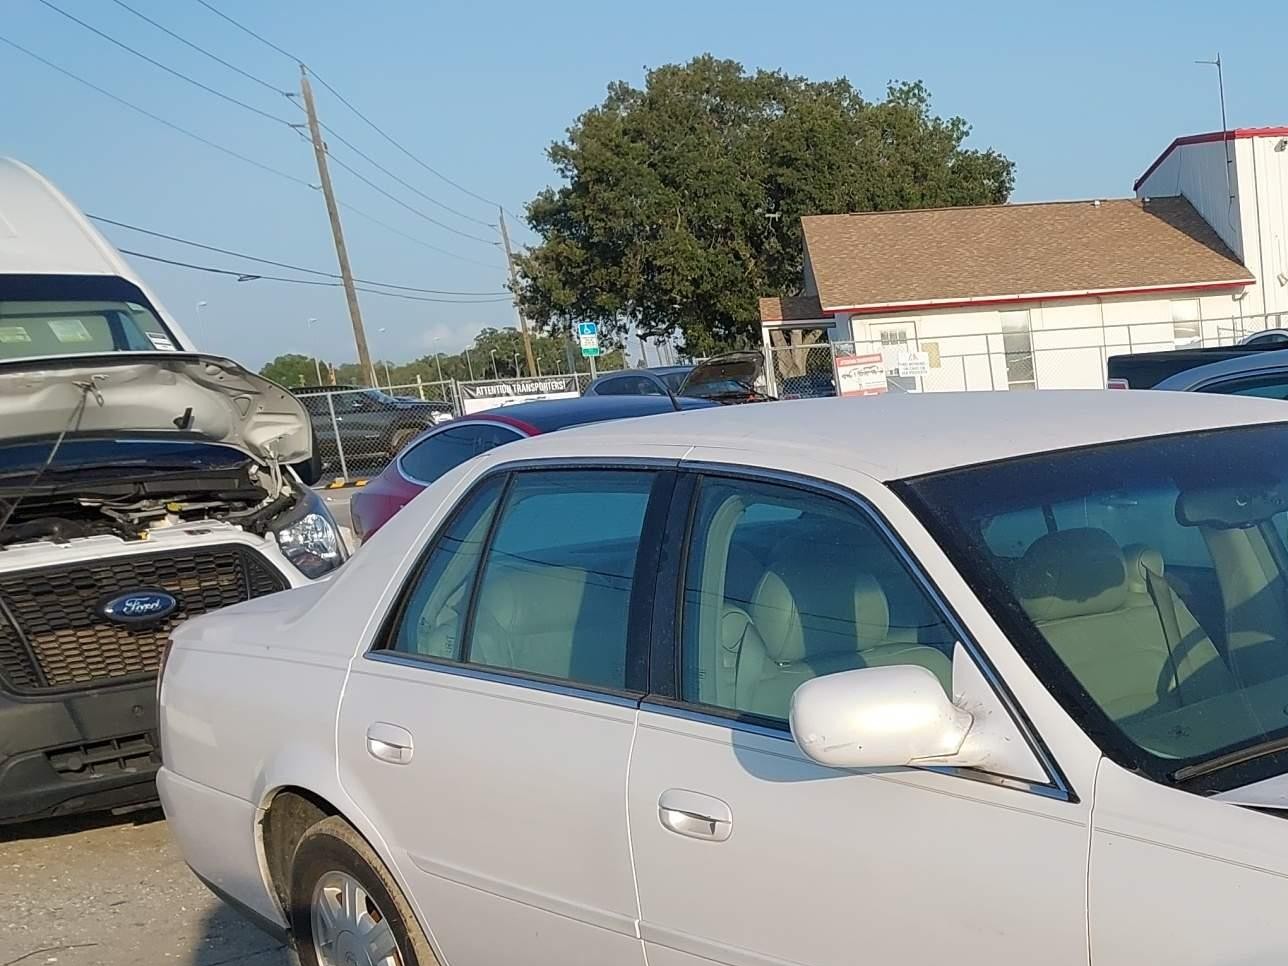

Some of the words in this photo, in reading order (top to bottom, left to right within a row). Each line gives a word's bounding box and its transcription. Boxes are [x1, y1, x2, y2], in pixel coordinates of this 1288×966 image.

[476, 384, 512, 396] ATTENTION
[512, 378, 566, 394] TRANSPORTERS!
[122, 597, 161, 614] Ford
